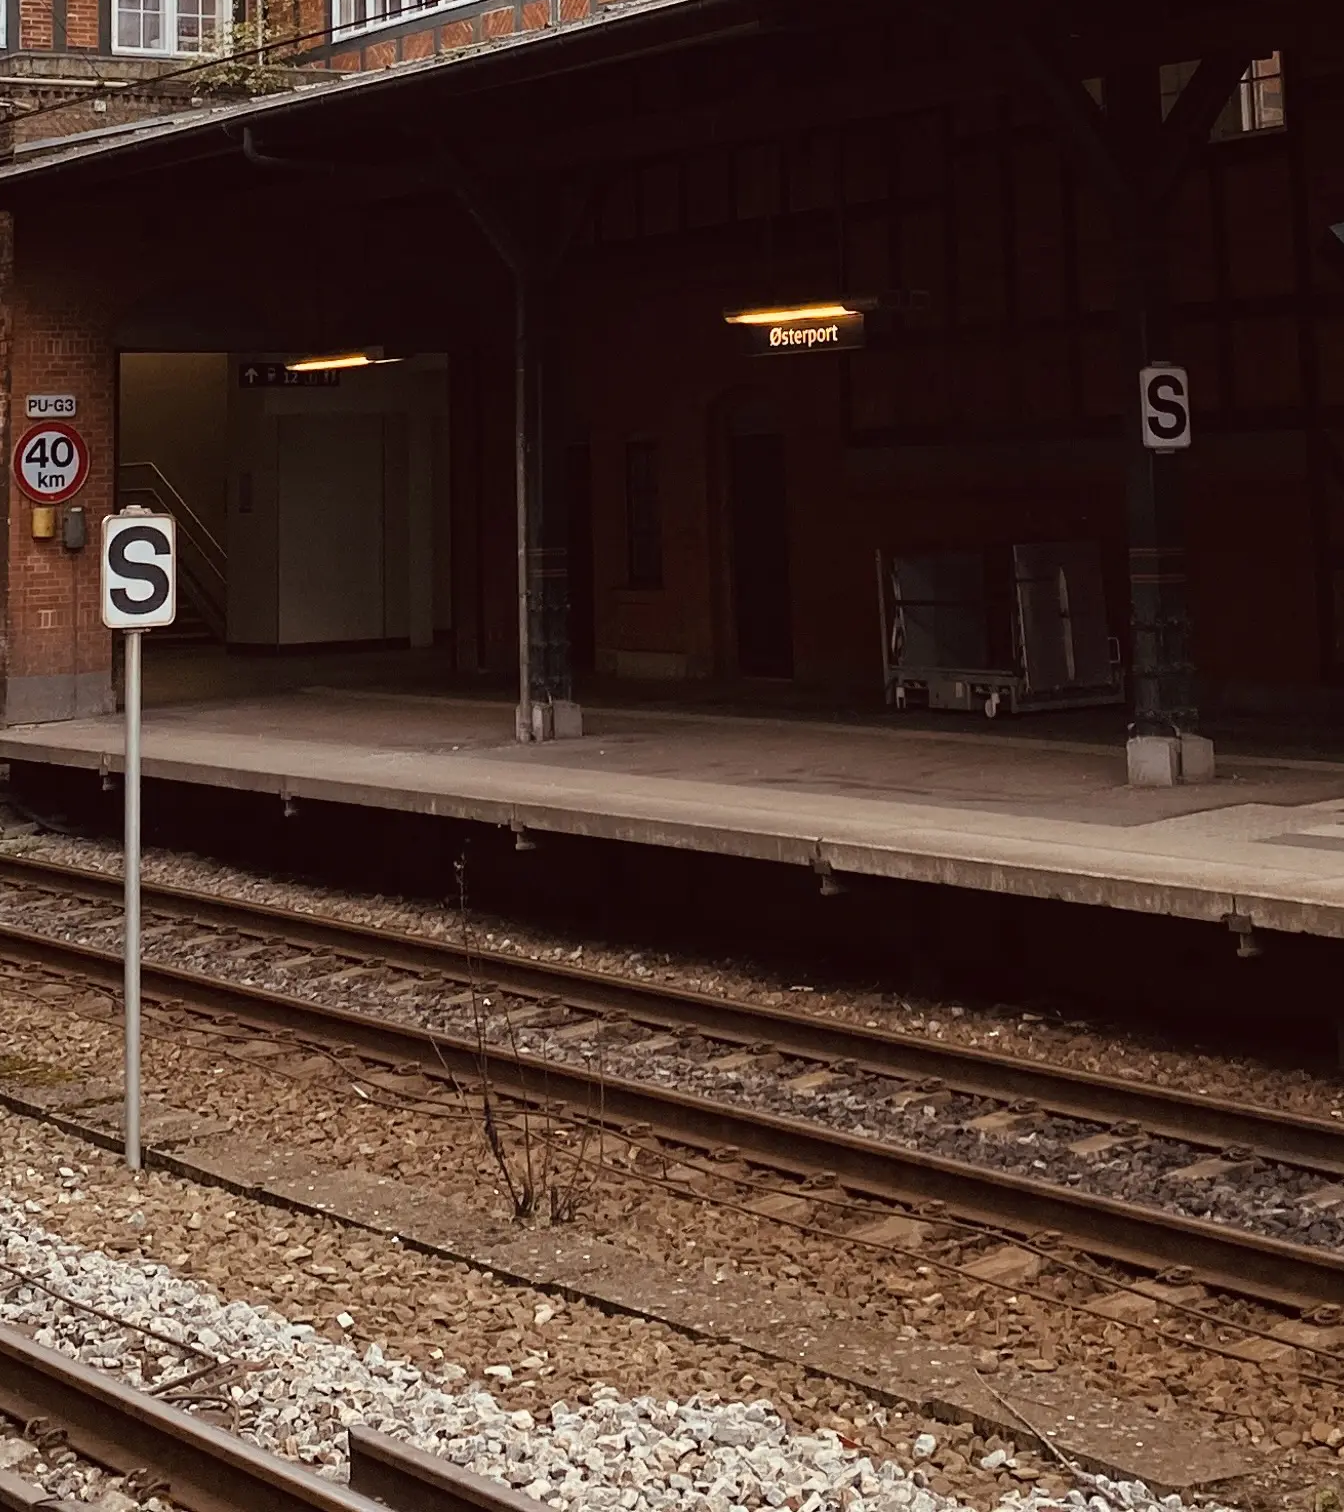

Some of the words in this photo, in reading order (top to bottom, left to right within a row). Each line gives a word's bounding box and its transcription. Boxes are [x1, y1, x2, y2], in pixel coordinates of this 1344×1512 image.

[769, 324, 838, 348] Østerport
[28, 398, 75, 413] PU-G3
[1147, 374, 1187, 440] S
[25, 436, 75, 469] 40
[37, 471, 66, 489] km
[108, 525, 172, 616] S
